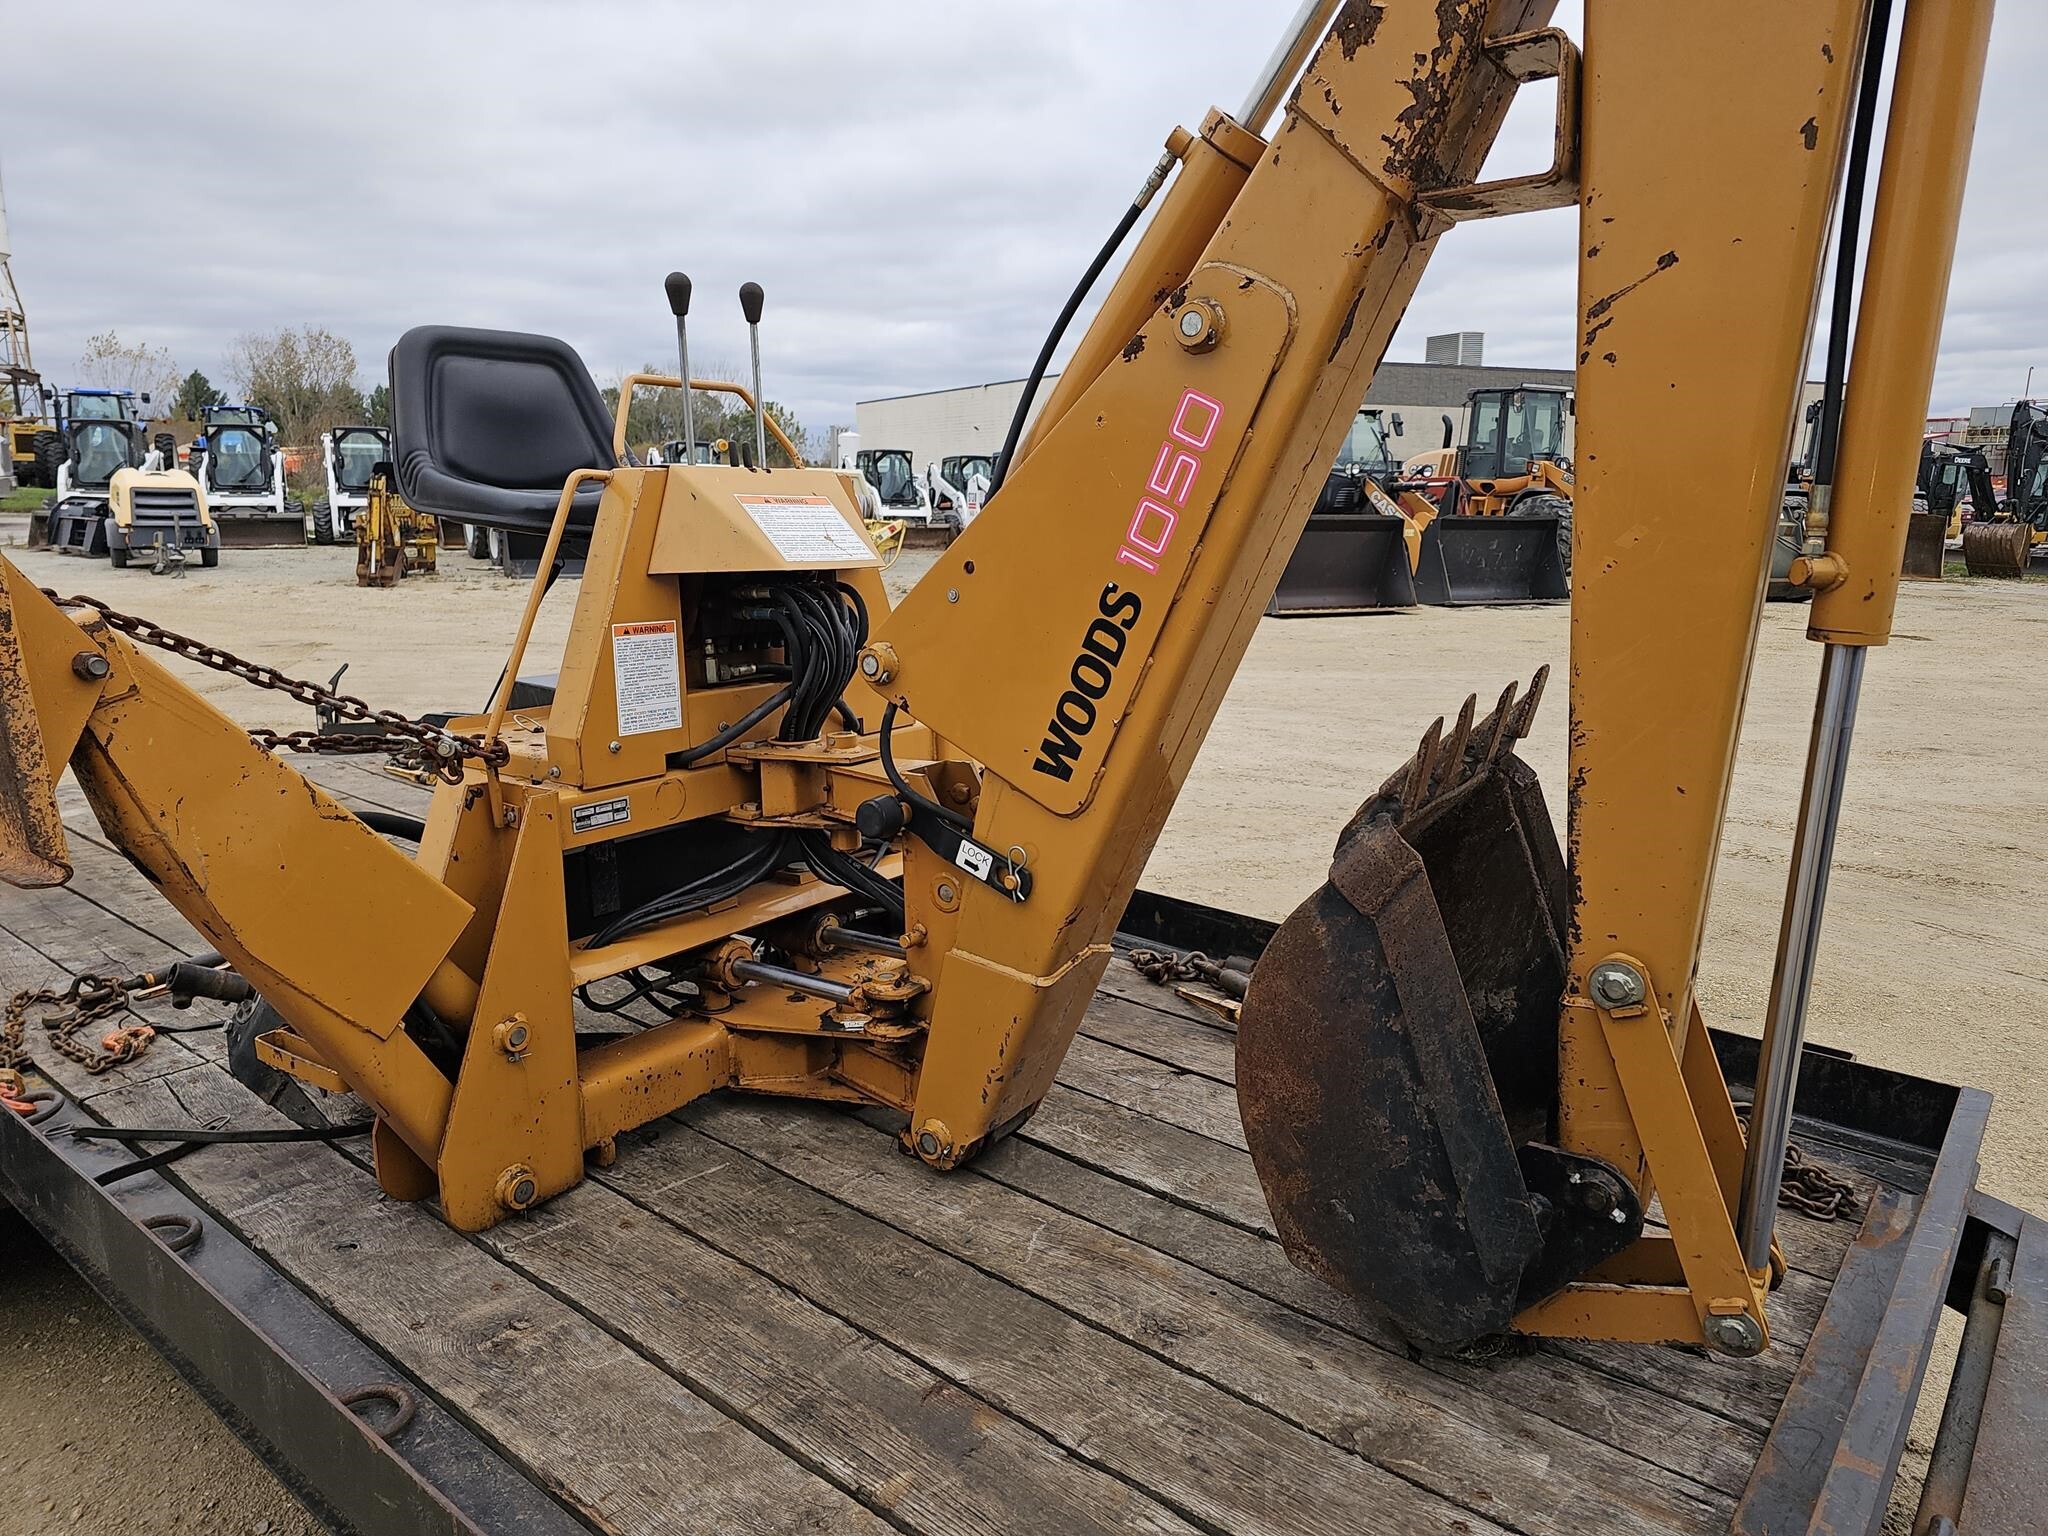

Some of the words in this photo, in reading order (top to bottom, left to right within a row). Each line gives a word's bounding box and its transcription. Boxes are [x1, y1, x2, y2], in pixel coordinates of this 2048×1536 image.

[1115, 387, 1224, 576] 1050
[774, 497, 809, 505] WARNING
[632, 624, 667, 635] WARNING
[1031, 581, 1142, 783] WOODS
[962, 844, 989, 867] LOCK
